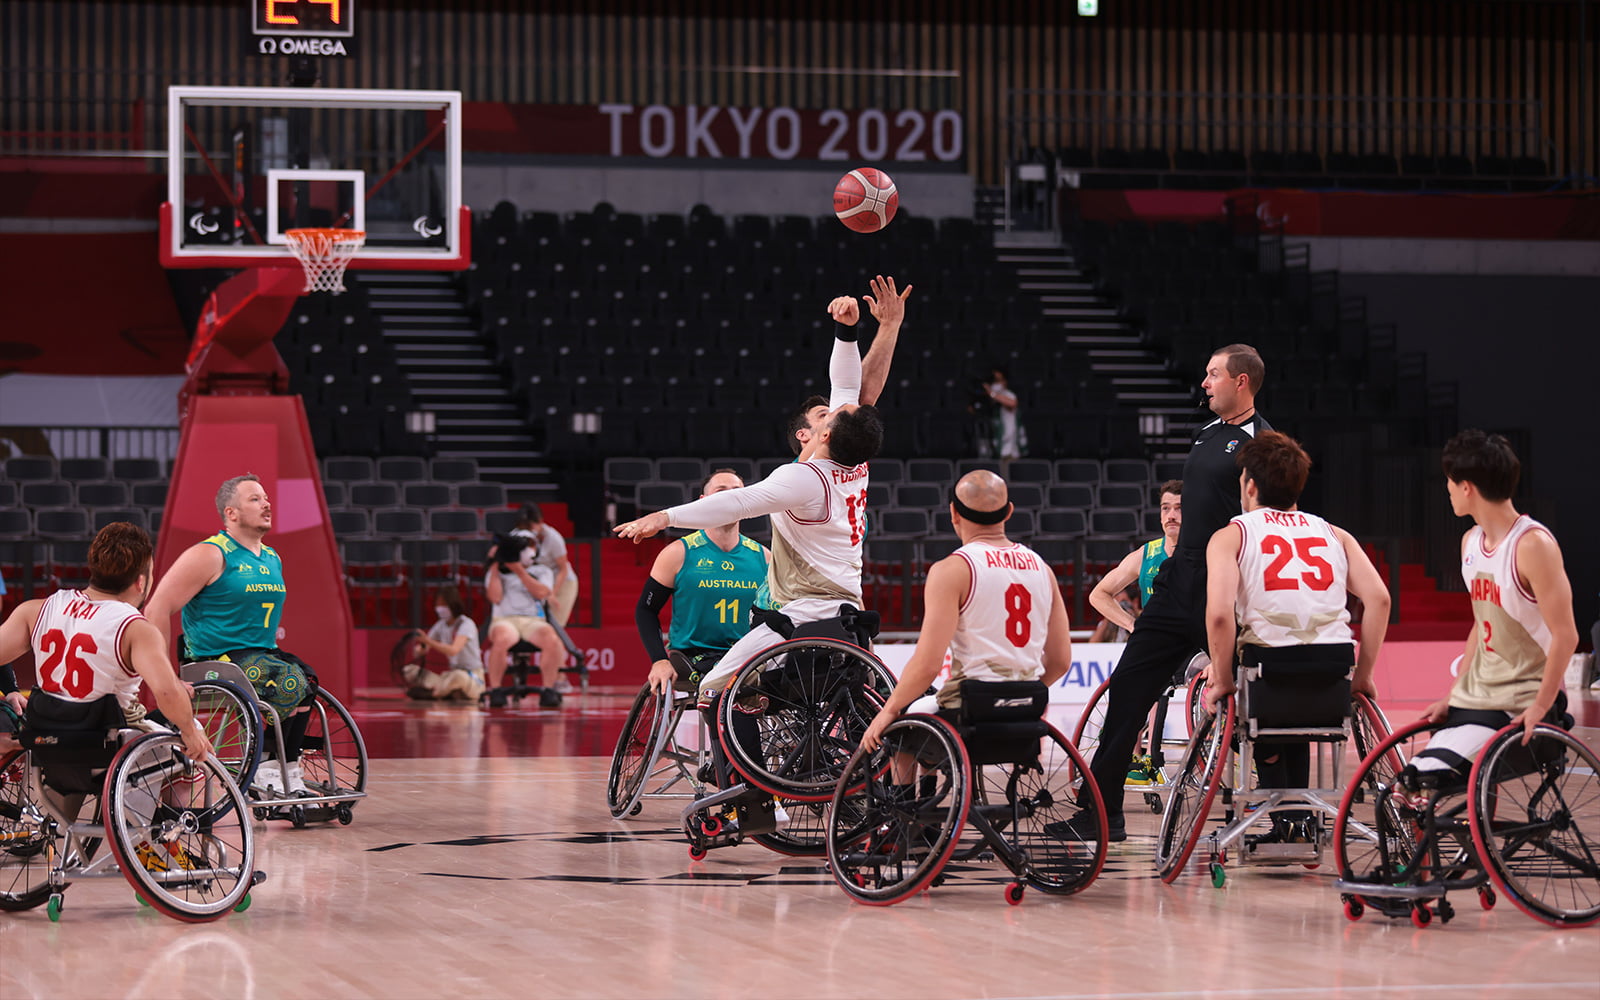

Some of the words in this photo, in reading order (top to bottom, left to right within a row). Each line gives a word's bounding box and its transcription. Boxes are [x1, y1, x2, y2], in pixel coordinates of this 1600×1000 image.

[280, 37, 347, 56] OMEGA
[600, 104, 800, 158] TOKYO
[819, 109, 962, 161] 2020
[1264, 511, 1310, 527] AKITA
[985, 550, 1040, 571] AKAISHI
[1260, 534, 1335, 592] 25
[698, 579, 758, 589] AUSTRALIA
[261, 602, 275, 628] 7
[714, 598, 739, 624] 11
[1004, 583, 1032, 648] 8
[40, 628, 98, 699] 26
